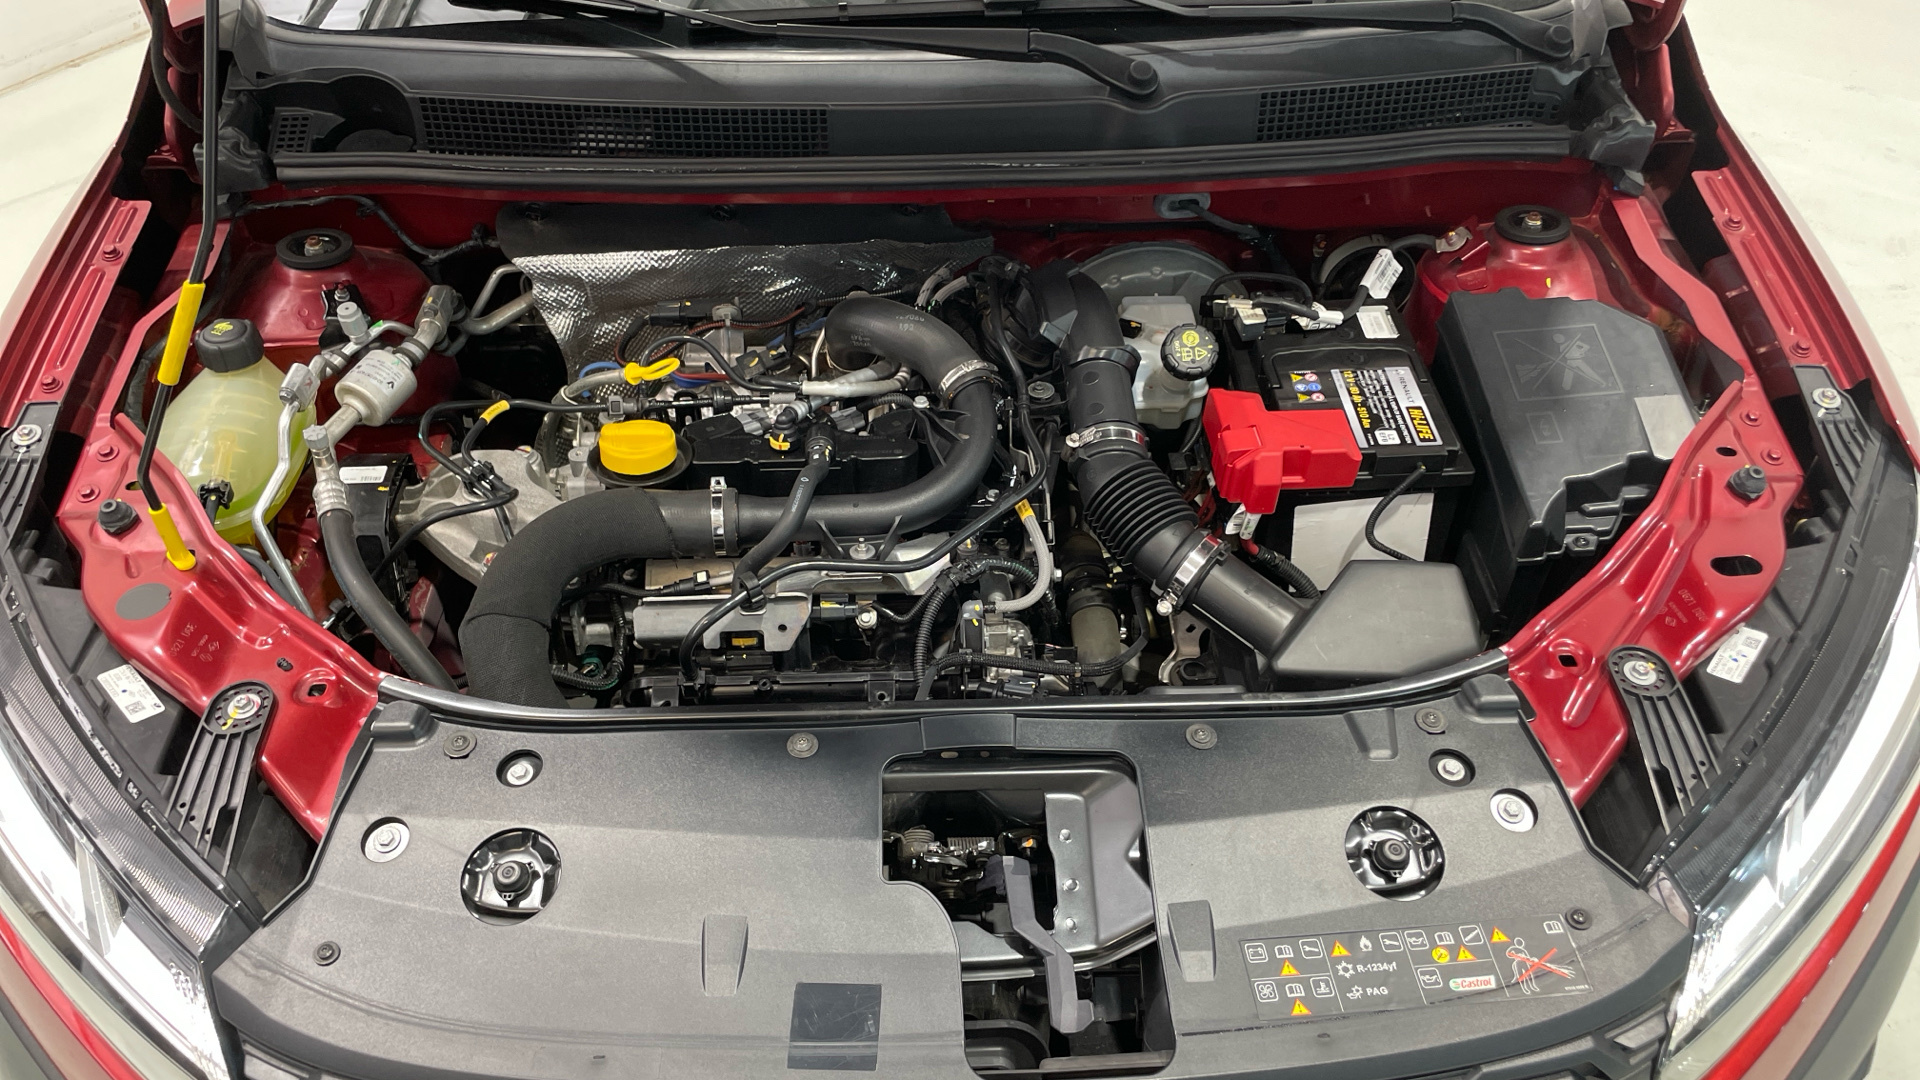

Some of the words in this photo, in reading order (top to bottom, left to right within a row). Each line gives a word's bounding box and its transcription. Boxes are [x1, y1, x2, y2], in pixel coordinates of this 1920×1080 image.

[1173, 340, 1181, 351] DOT
[1399, 376, 1415, 403] RENAULT
[1355, 961, 1398, 974] R-1234yf
[1460, 977, 1492, 989] Castrol
[1365, 986, 1389, 997] PAG
